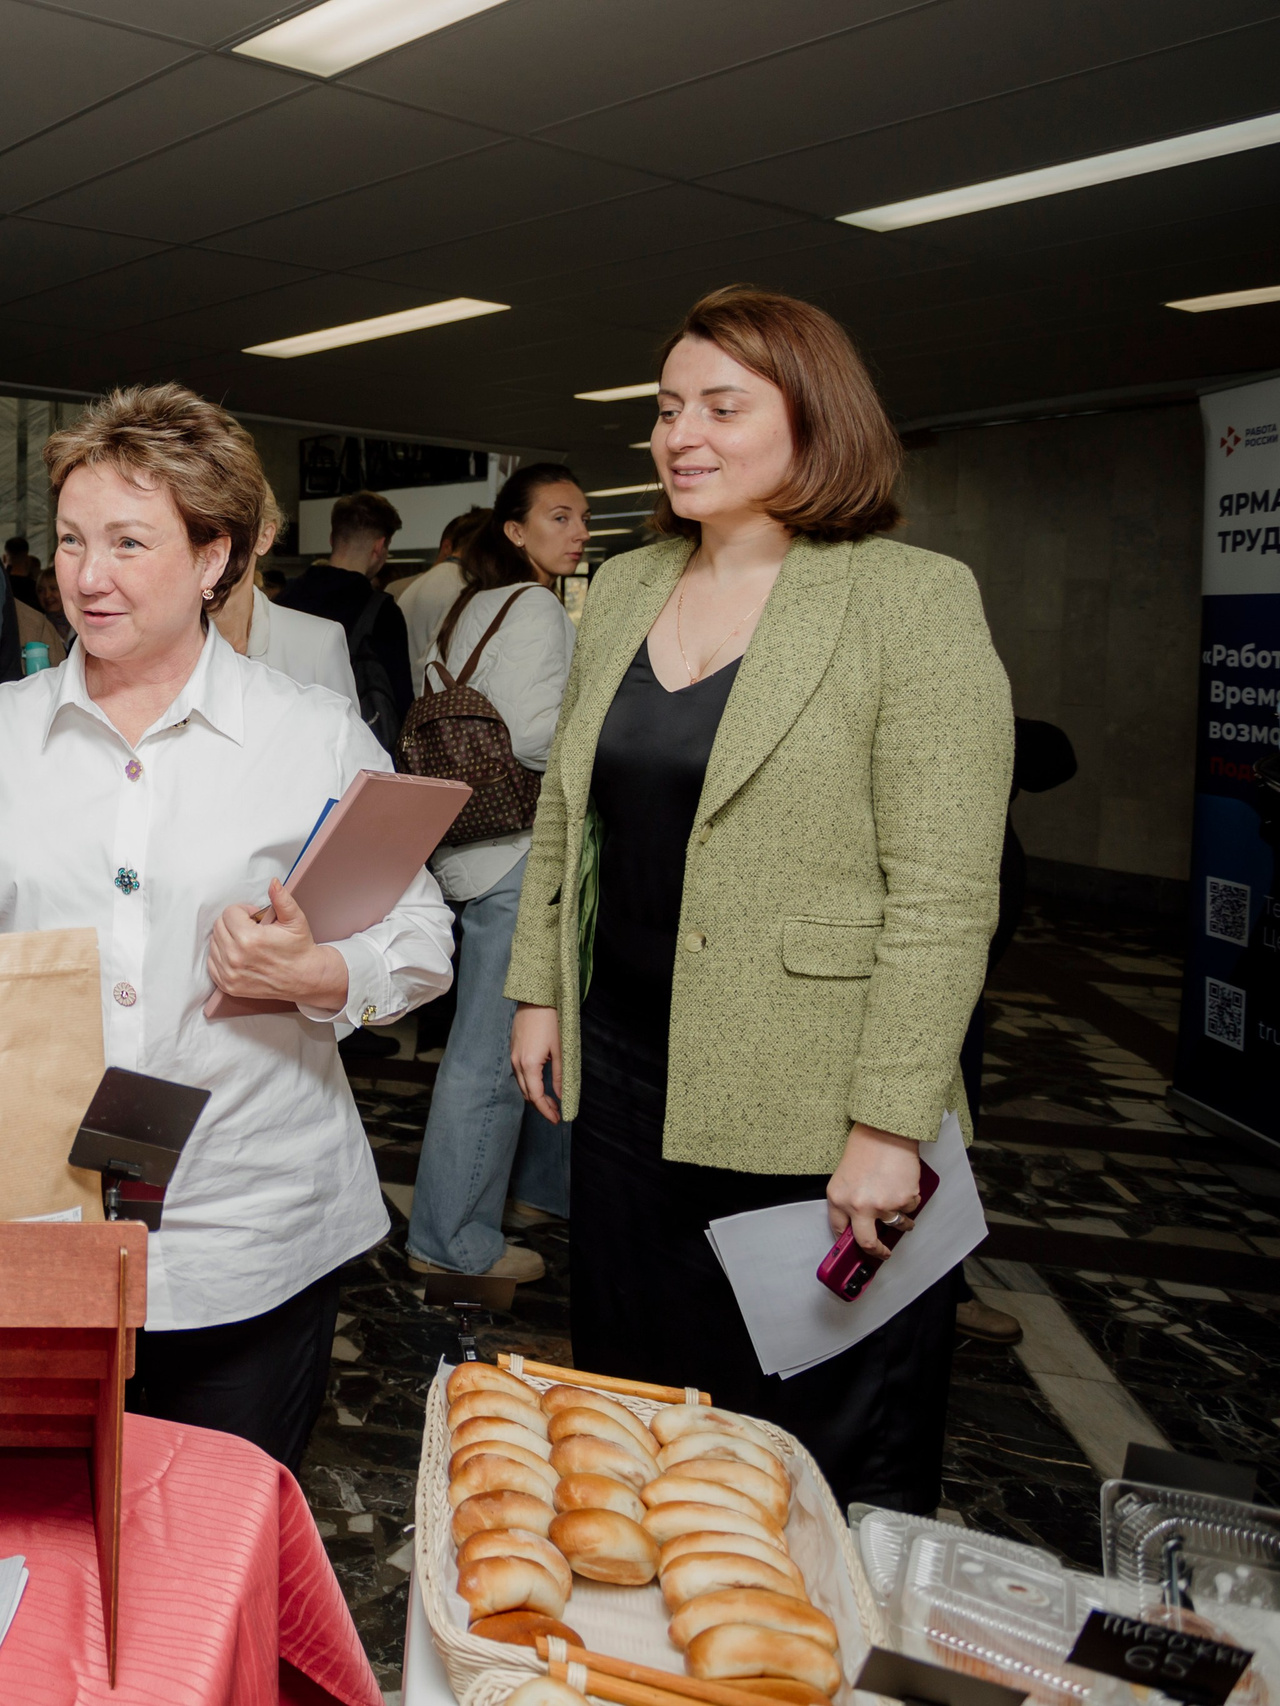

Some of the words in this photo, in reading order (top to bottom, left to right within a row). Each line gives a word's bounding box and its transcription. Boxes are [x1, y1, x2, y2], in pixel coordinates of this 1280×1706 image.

[1245, 423, 1277, 437] РАБОТА
[1245, 434, 1279, 448] РОССИИ
[1217, 526, 1280, 555] ТРУД
[1102, 1614, 1249, 1669] ПИРОЖКИ
[1123, 1644, 1197, 1679] 65
